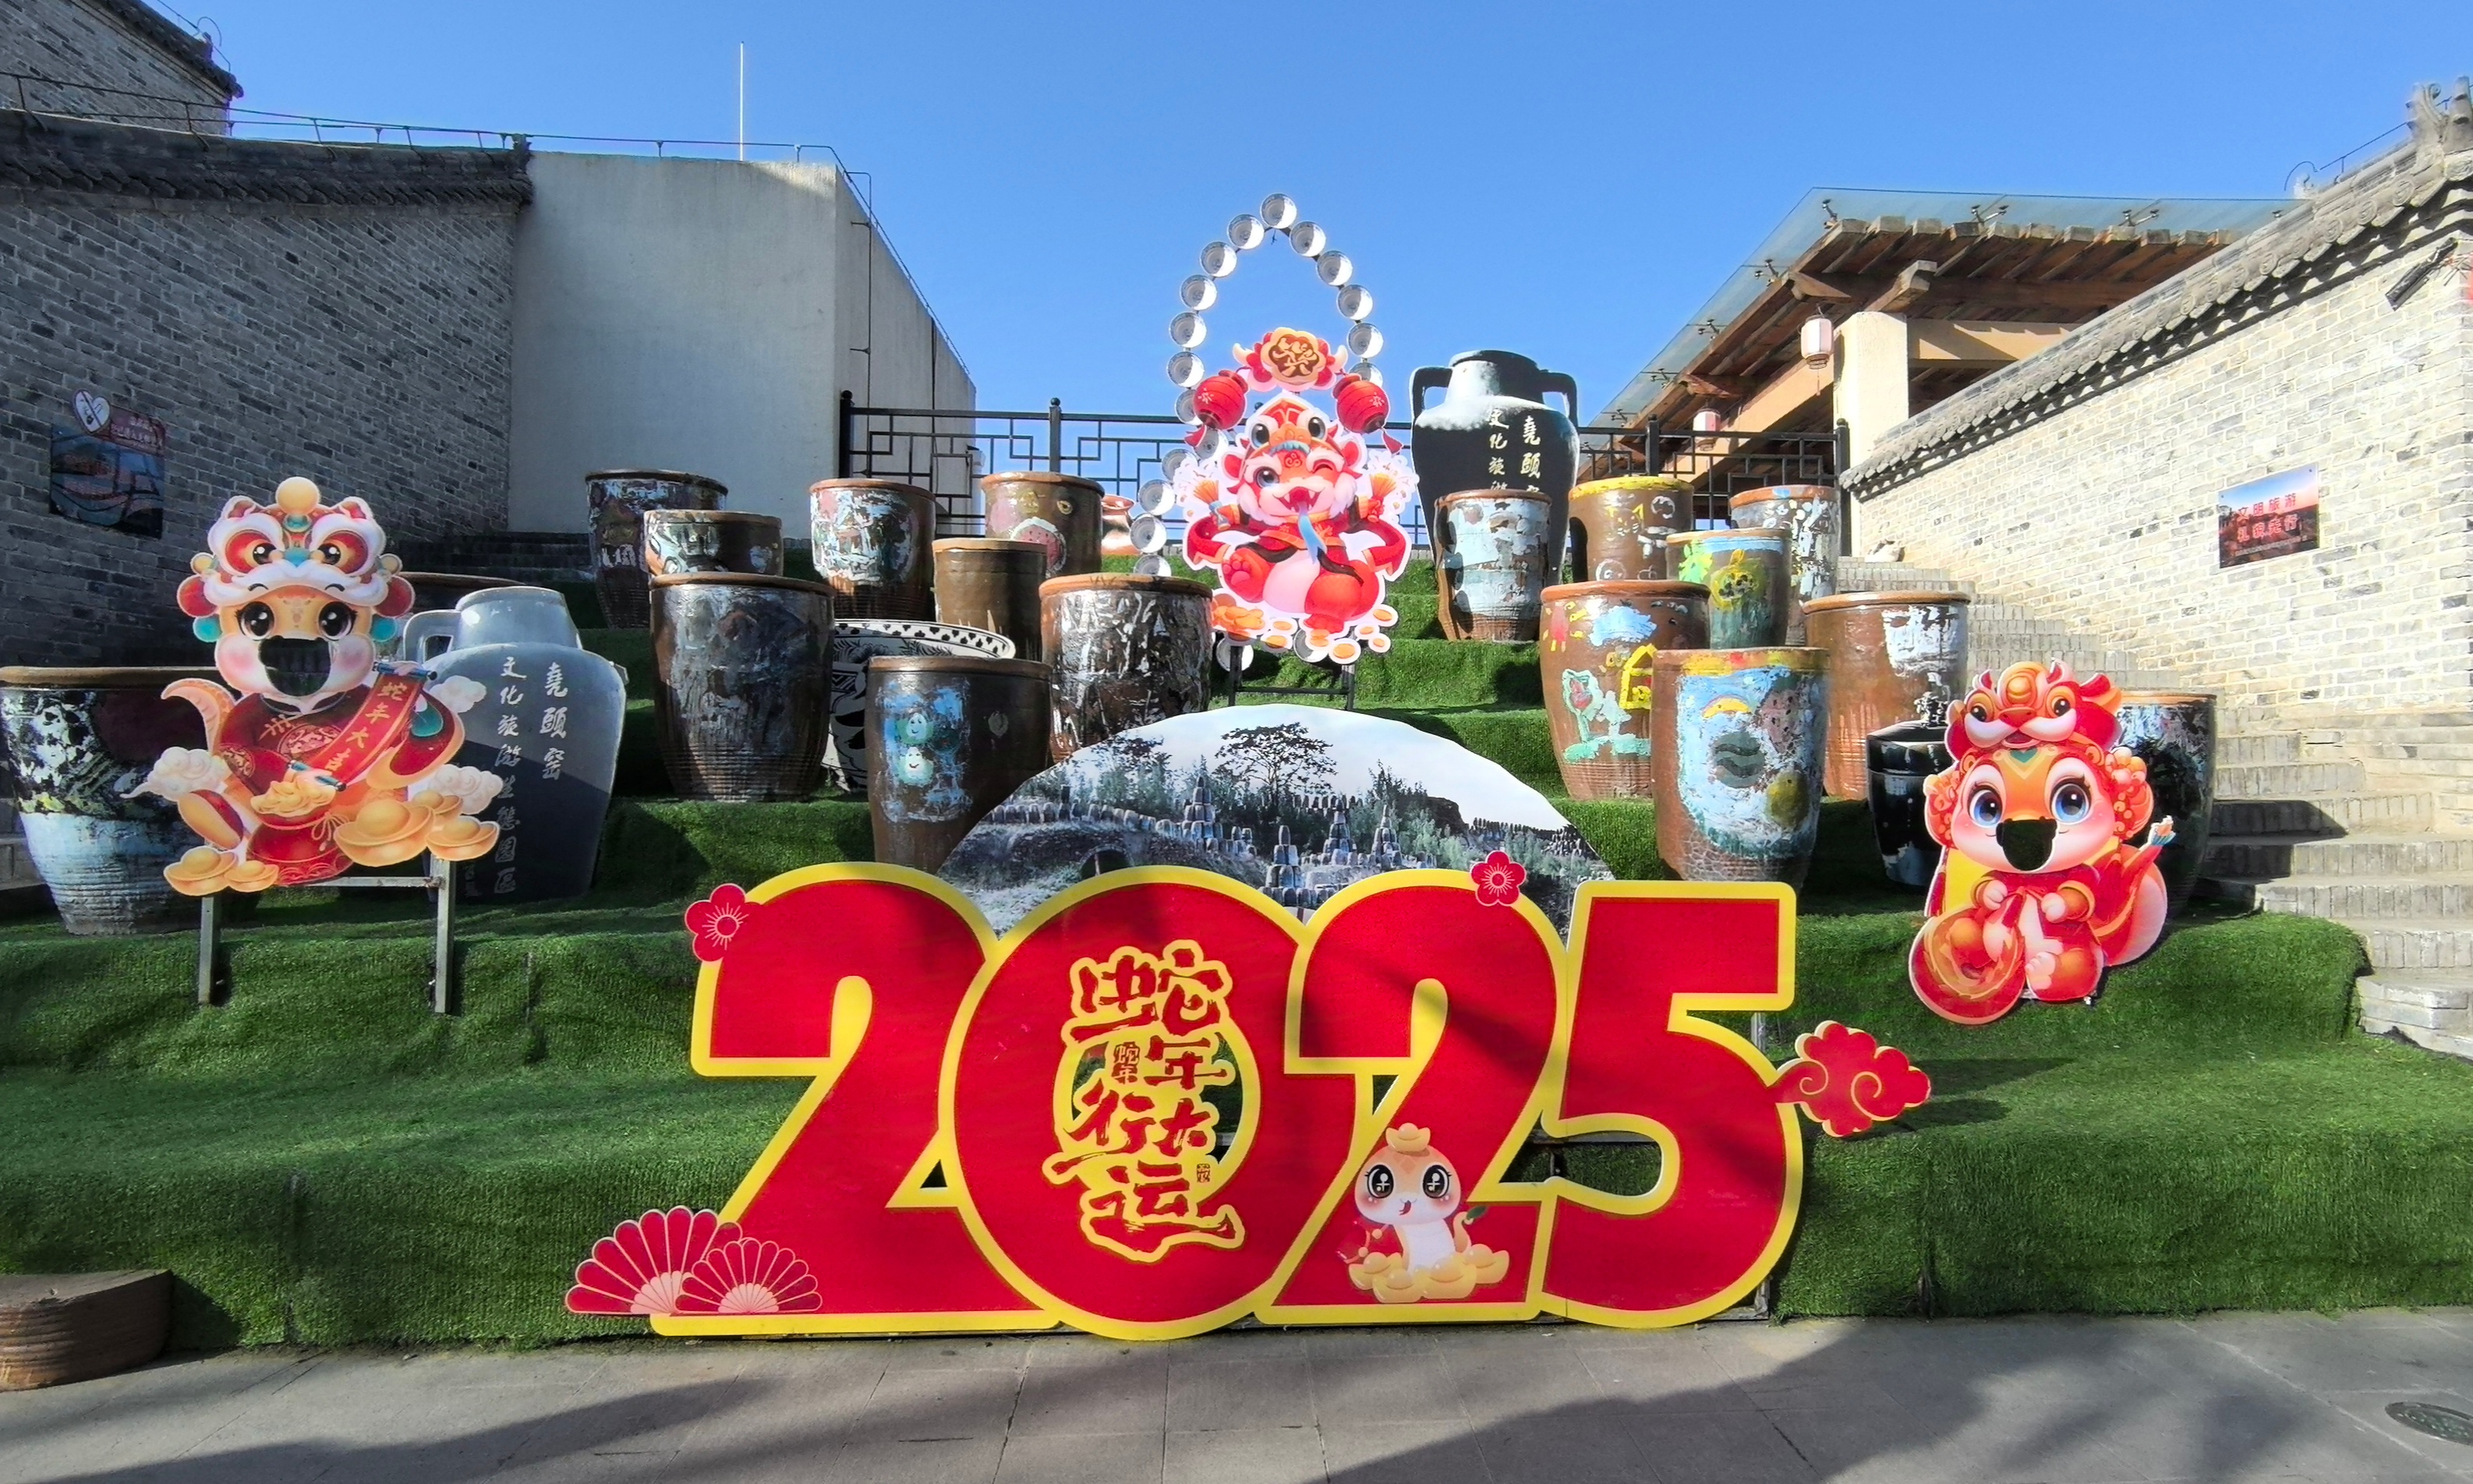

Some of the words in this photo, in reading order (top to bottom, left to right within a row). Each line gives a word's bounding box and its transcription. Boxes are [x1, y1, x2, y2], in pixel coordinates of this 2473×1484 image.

[2236, 493, 2296, 523] 文明旅游
[324, 681, 407, 772] 蛇年大吉
[650, 861, 1804, 1341] 2025
